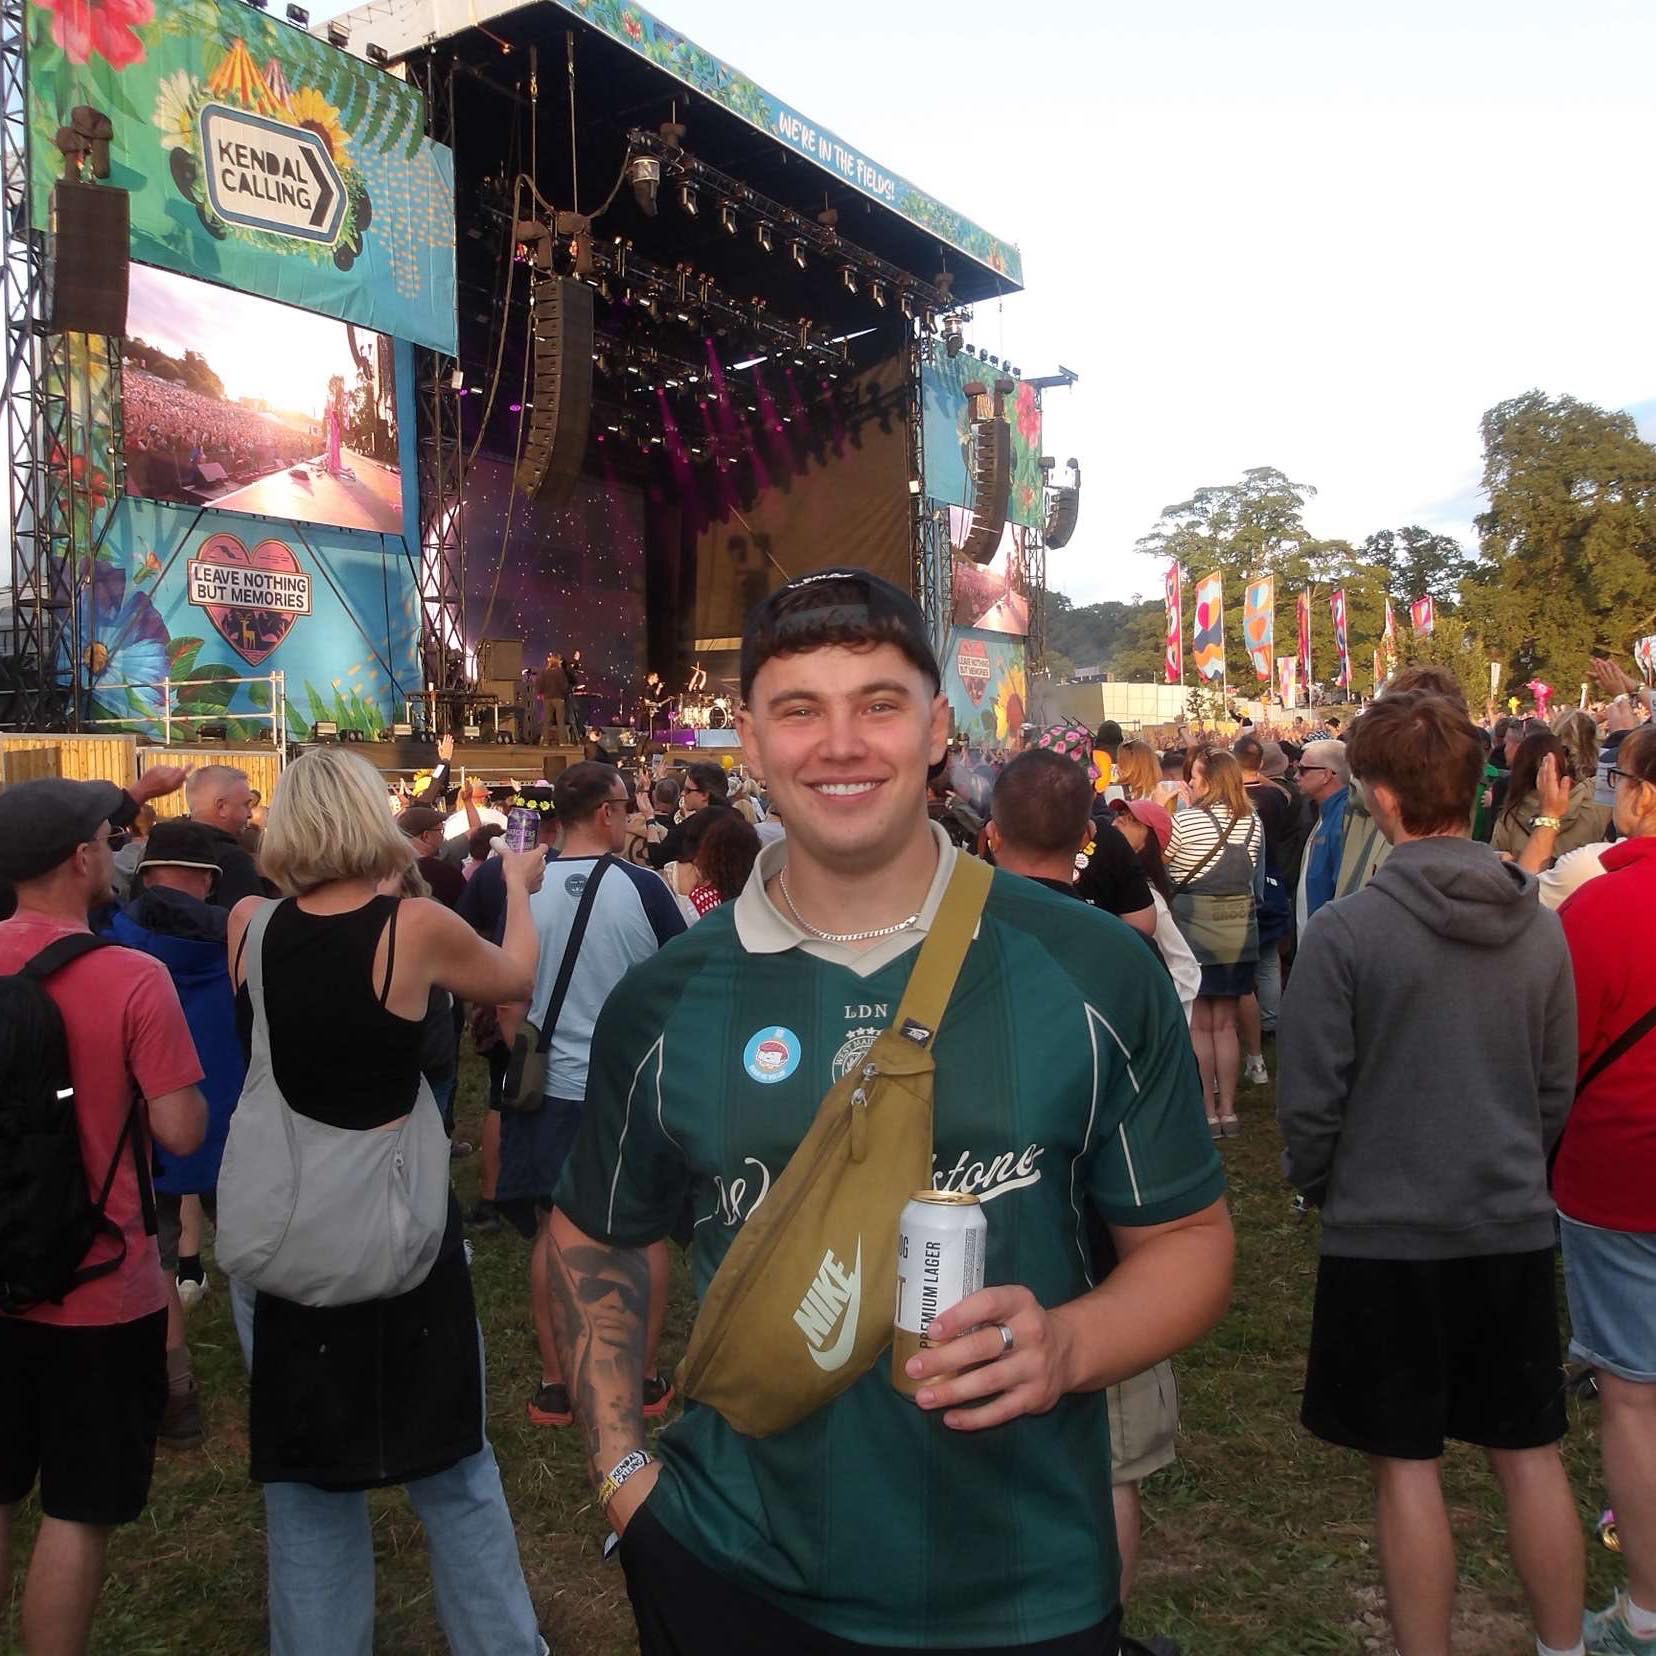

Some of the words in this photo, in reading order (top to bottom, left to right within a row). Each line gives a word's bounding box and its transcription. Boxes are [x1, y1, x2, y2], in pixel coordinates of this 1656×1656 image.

[218, 139, 308, 184] KENDAL
[779, 111, 816, 152] WE'RE
[819, 136, 832, 162] IN
[833, 145, 855, 177] THE
[221, 168, 312, 210] CALLING
[194, 566, 240, 585] LEAVE
[244, 573, 306, 593] NOTHING
[197, 584, 226, 601] BUT
[231, 588, 304, 608] MEMORIES
[924, 1241, 941, 1283] LAGER
[793, 1248, 855, 1349] NIKE
[613, 1454, 638, 1479] KENDAL
[618, 1459, 643, 1484] CALLING
